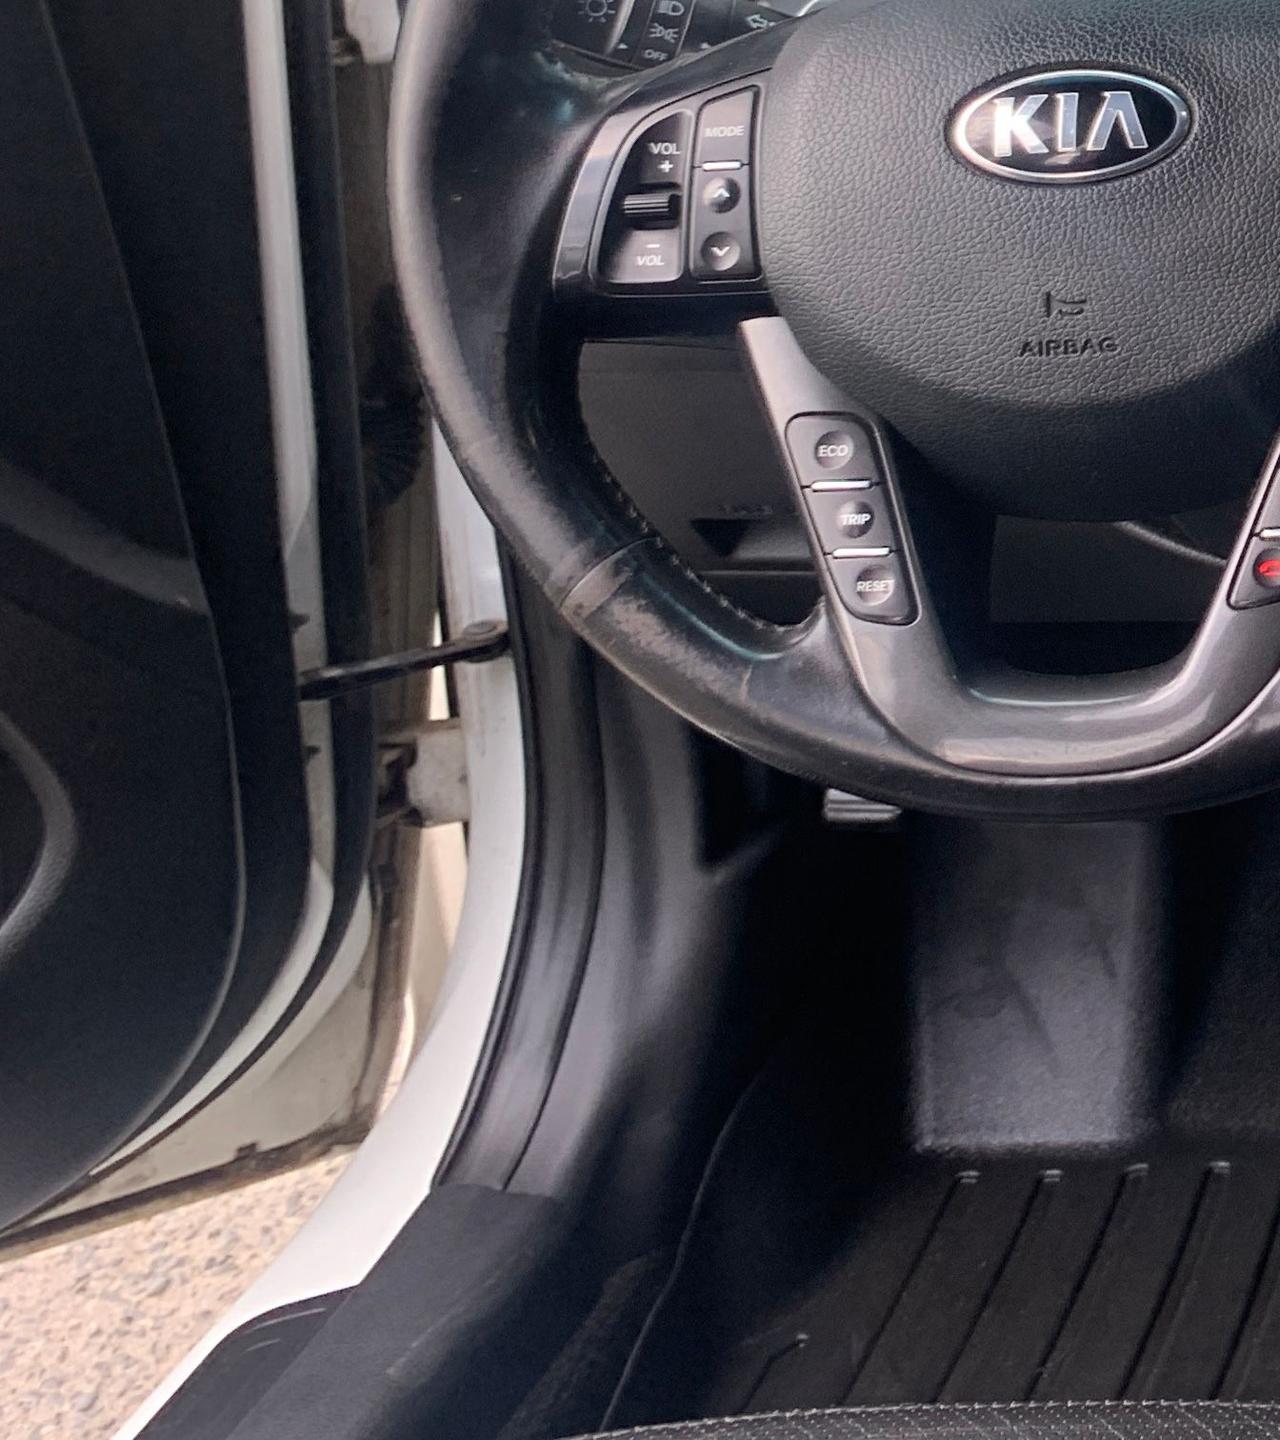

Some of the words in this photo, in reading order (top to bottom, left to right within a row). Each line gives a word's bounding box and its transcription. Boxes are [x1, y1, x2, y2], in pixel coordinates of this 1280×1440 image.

[643, 49, 668, 61] OFF
[993, 92, 1148, 157] KIA
[705, 125, 744, 138] MODE
[649, 143, 681, 155] VOL
[636, 255, 665, 266] VOL
[1019, 336, 1118, 358] AIRBAG
[818, 445, 848, 457] ECO
[840, 513, 871, 525] TRIP
[857, 581, 894, 592] RESET
